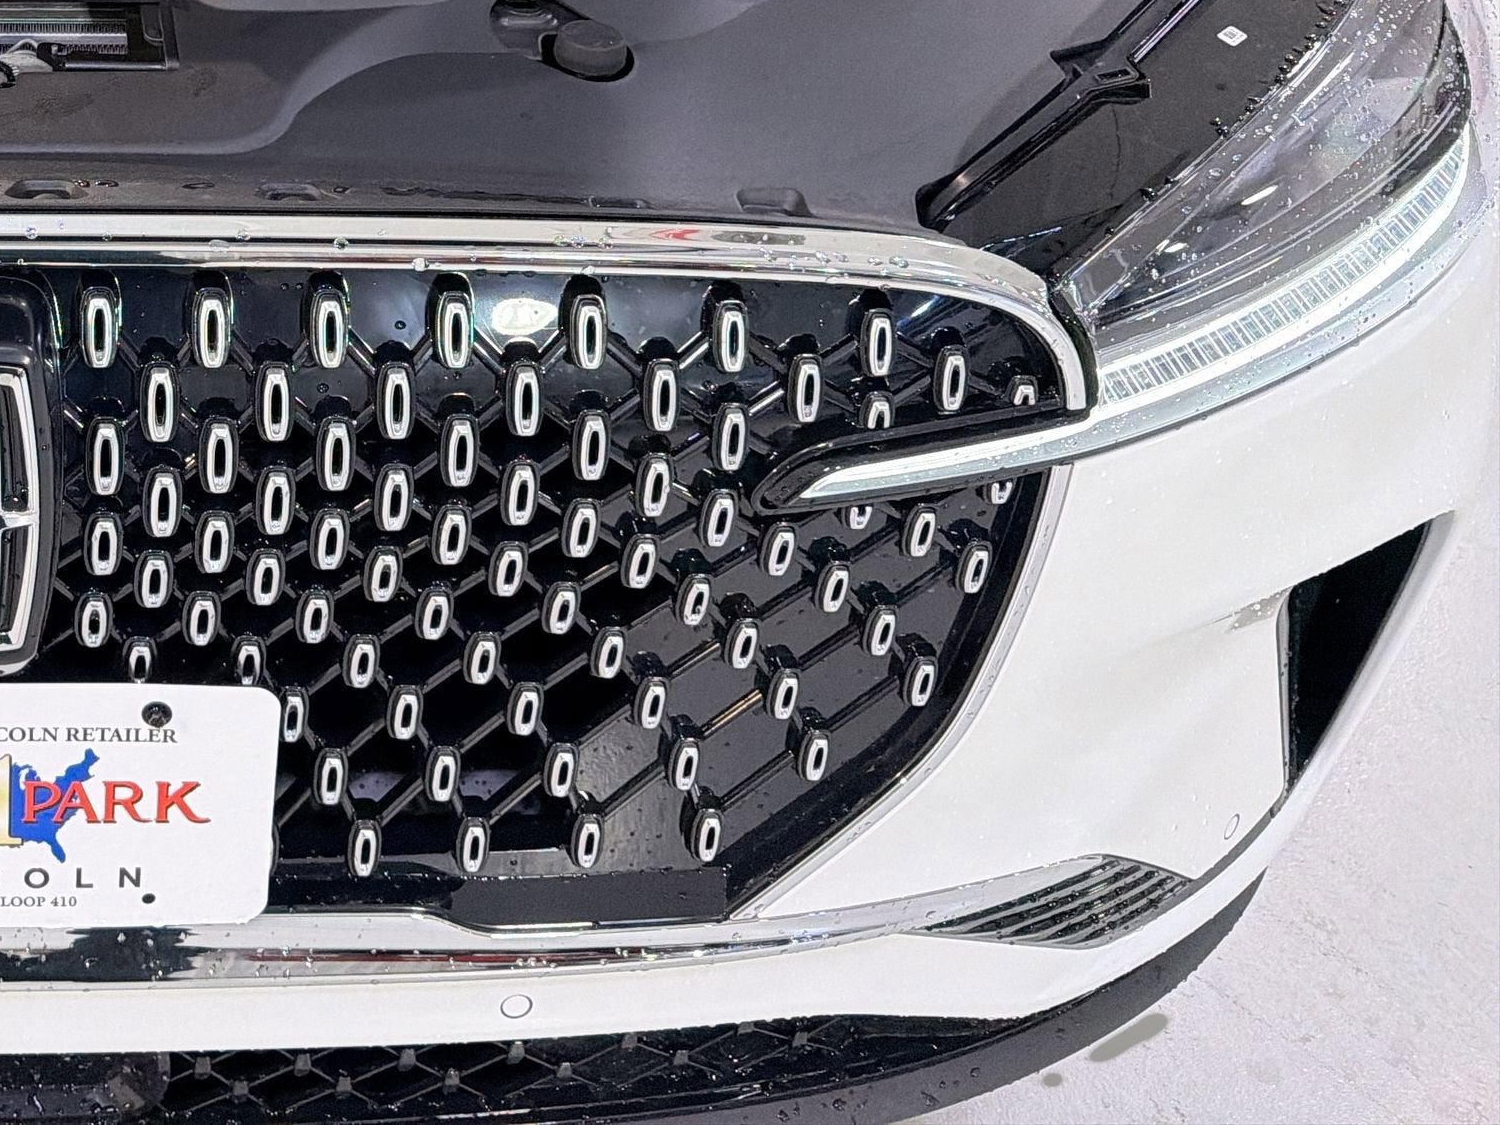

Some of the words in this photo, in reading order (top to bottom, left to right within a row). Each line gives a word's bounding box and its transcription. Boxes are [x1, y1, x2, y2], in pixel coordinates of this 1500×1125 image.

[65, 727, 178, 743] RETAILER
[21, 780, 211, 824] PARK
[0, 896, 46, 908] LOOP
[50, 896, 77, 908] 410
